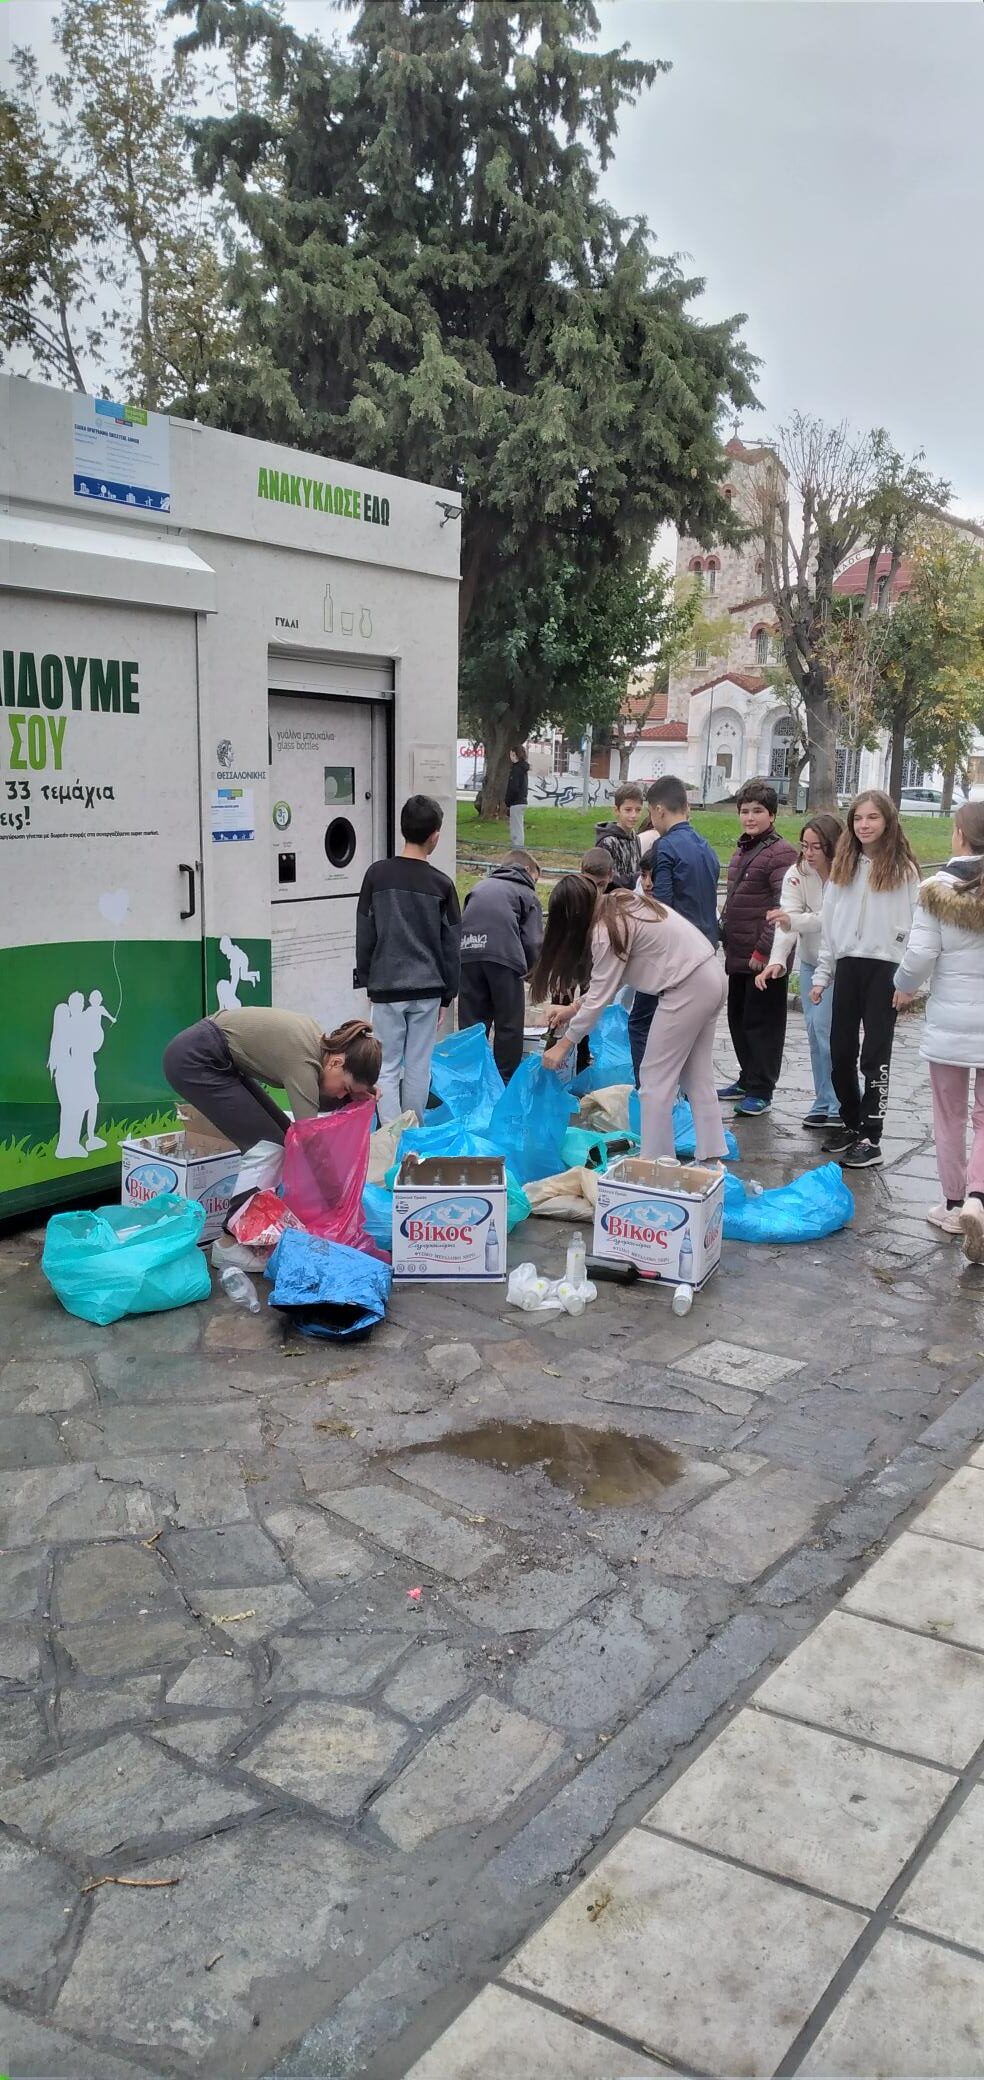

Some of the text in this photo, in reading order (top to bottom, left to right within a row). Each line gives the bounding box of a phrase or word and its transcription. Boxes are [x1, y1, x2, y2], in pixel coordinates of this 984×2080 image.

[257, 467, 390, 526] ΑΝΑΚΥΚΛΩΣΕ ΕΔΩ
[275, 616, 299, 629] ΓΥΑΛΙ
[0, 650, 140, 715] ΙΔΟΥΜΕ
[8, 713, 67, 771] ΣΟΥ
[277, 741, 319, 751] glass bottles
[216, 771, 267, 780] ΘΕΣΣΑΛΟΝΙΚΗΣ
[5, 778, 115, 809] 33 τεμάχια
[867, 1064, 889, 1119] benetton
[130, 1178, 158, 1203] Βίκο
[408, 1220, 473, 1246] Βίκος
[608, 1215, 668, 1250] Βίκος
